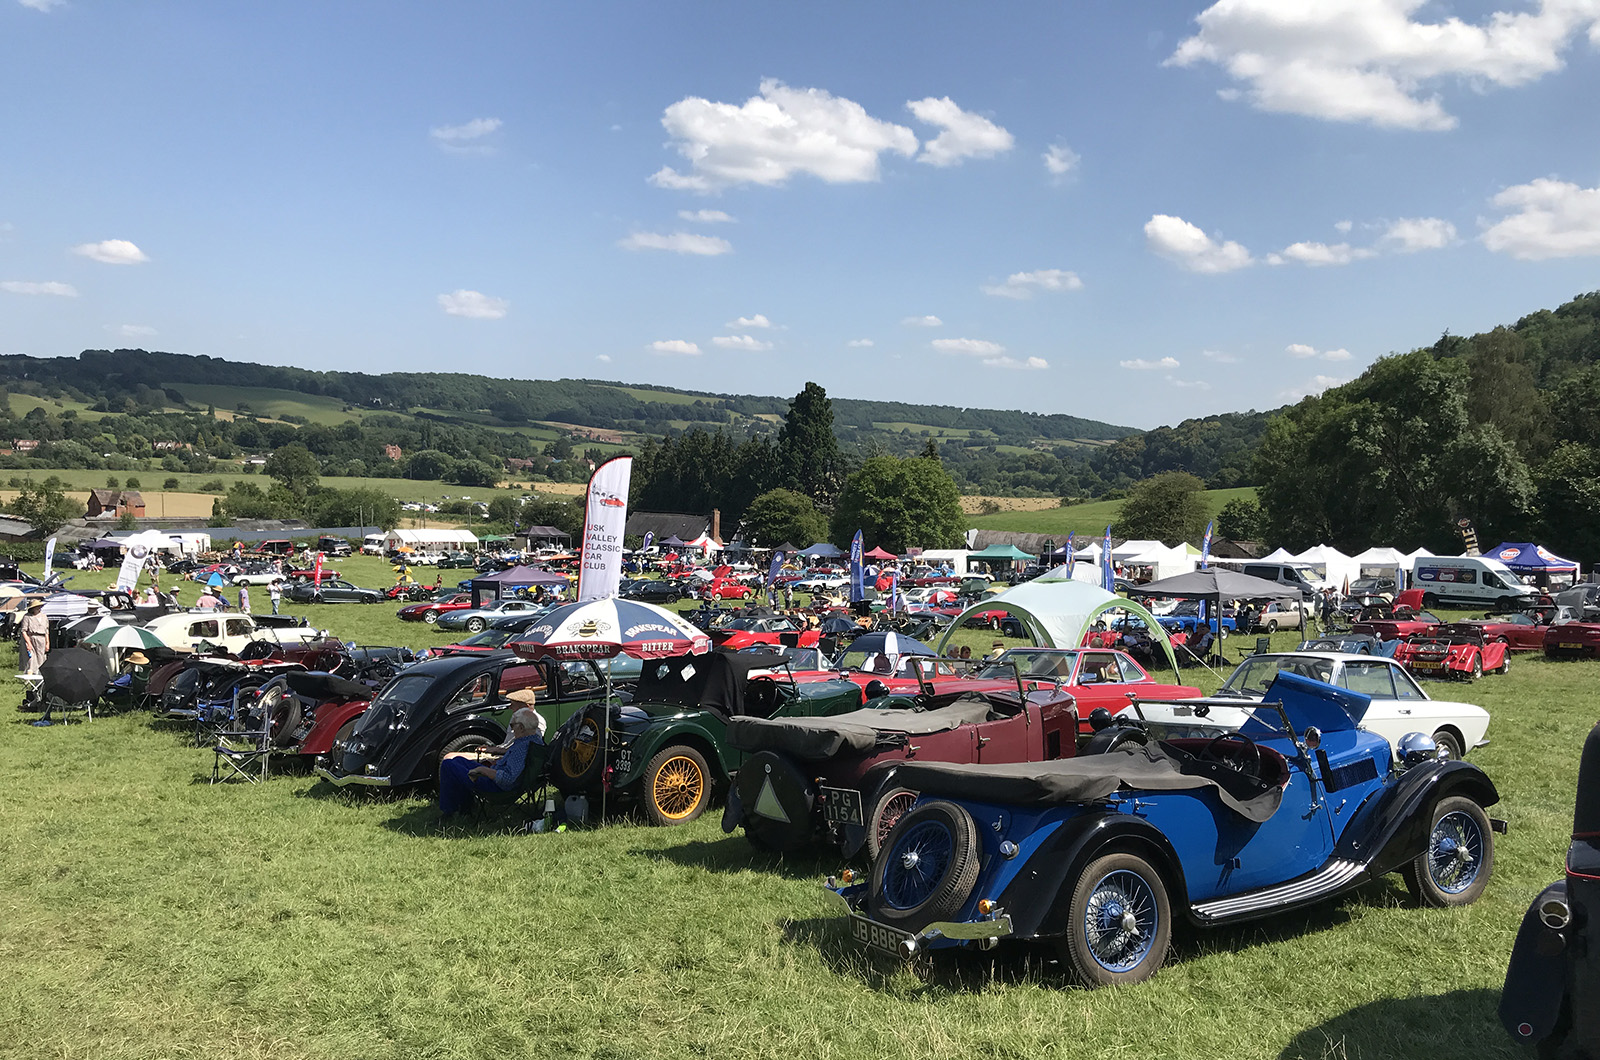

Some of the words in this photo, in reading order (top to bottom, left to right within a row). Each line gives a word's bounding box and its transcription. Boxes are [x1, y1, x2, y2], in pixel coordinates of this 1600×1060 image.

[587, 524, 605, 532] USK
[586, 533, 617, 543] VALLEY
[585, 542, 621, 552] CLASSIC
[584, 552, 602, 561] CAR
[583, 561, 606, 570] CLUB
[624, 623, 678, 638] BRAKSPEAR
[555, 644, 611, 654] BRAKSPEAR
[641, 642, 674, 652] BITTER
[831, 791, 851, 807] PG
[827, 805, 858, 822] 1154
[852, 920, 868, 941] JB
